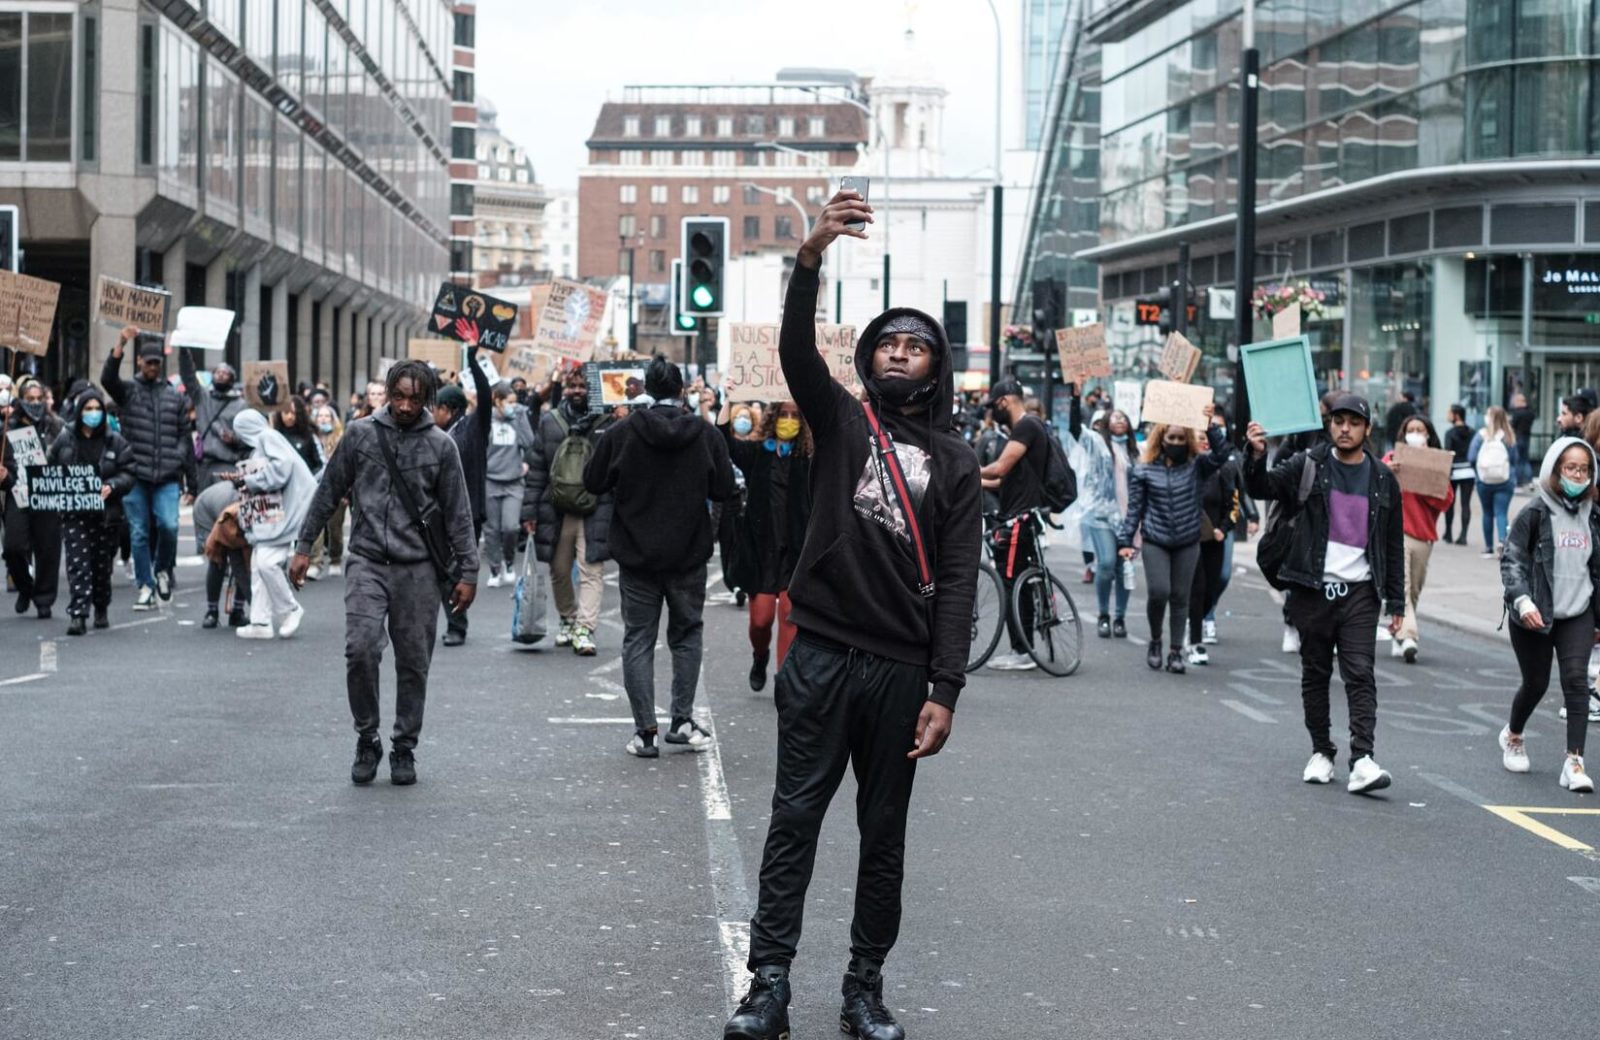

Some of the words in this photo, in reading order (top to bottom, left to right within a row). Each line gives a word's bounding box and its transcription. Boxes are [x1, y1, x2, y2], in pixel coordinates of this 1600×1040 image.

[103, 282, 125, 301] HOW
[127, 290, 161, 309] MANY
[1137, 303, 1161, 322] T2
[731, 325, 780, 345] INJUST
[746, 351, 759, 365] A
[837, 354, 854, 365] TO
[734, 364, 788, 388] JUSTIC
[42, 465, 63, 478] USE
[67, 464, 95, 478] YOUR
[32, 477, 86, 494] PRIVILEGE
[86, 476, 102, 491] TO
[30, 493, 66, 511] CHANGE
